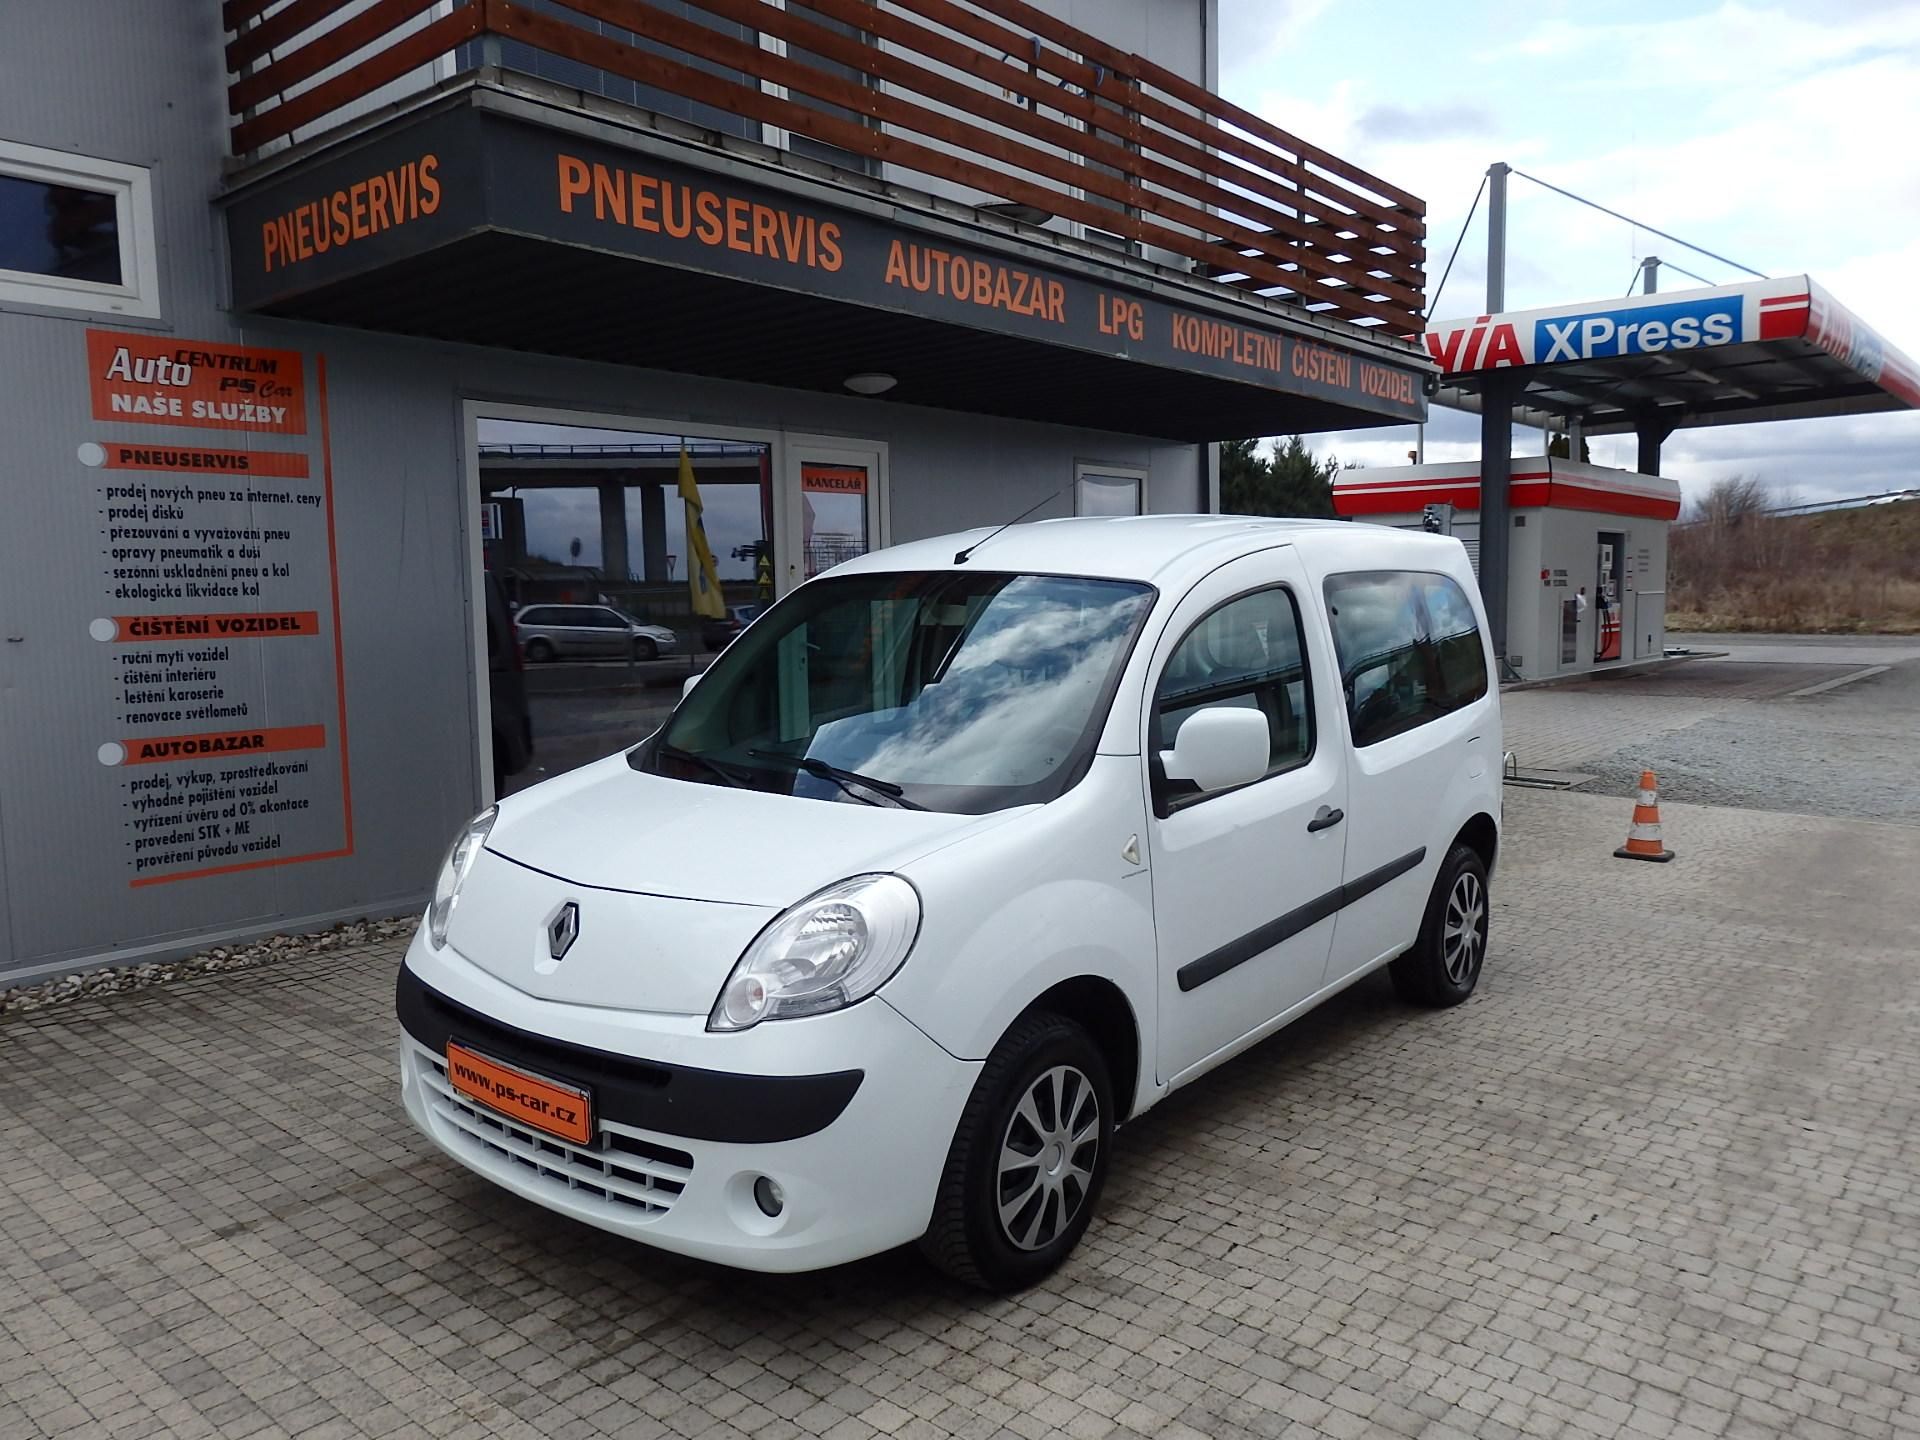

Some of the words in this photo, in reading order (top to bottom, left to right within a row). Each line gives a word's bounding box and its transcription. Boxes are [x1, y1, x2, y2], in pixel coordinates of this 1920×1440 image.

[262, 154, 440, 272] PNEUSERVIS
[556, 153, 843, 272] PNEUSERVIS
[884, 239, 1065, 323] AUTOBAZAR
[1099, 293, 1143, 341] LPG
[1171, 313, 1282, 372] KOMPLETNÍ
[1292, 335, 1351, 388] ČIŠTĚNÍ
[1360, 363, 1415, 405] VOZIDEL
[1400, 316, 1525, 374] VIA
[1544, 312, 1733, 363] XPress
[105, 347, 192, 387] Auto
[175, 350, 277, 374] CENTRUM
[219, 377, 256, 393] PS
[259, 380, 293, 399] Car
[111, 392, 183, 417] NAŠE
[192, 399, 286, 424] SLUŽBY
[120, 449, 248, 470] PNEUSERVIS
[107, 483, 146, 502] prodej
[151, 485, 193, 503] nových
[198, 490, 226, 503] pneu
[229, 491, 243, 501] za
[247, 488, 294, 503] internet.
[296, 494, 321, 508] ceny
[108, 504, 148, 522] prodej
[110, 525, 179, 542] přezouvání
[182, 529, 190, 539] a
[264, 530, 290, 543] pneu
[112, 549, 155, 562] opravy
[161, 544, 223, 562] pneumatik
[227, 549, 235, 558] a
[164, 563, 228, 578] uskladnění
[231, 567, 258, 580] pneu
[262, 567, 269, 577] a
[272, 562, 290, 576] kol
[115, 583, 181, 601] ekologická
[186, 582, 238, 597] likvidace
[242, 581, 260, 596] kol
[129, 616, 209, 635] ČIŠTĚNÍ
[215, 616, 300, 633] VOZIDEL
[122, 651, 152, 664] ruční
[187, 646, 229, 661] vozidel
[169, 685, 224, 702] karoserie
[126, 710, 181, 723] renovace
[140, 734, 264, 758] AUTOBAZAR
[131, 772, 172, 794] prodej,
[239, 780, 278, 797] vozidel
[222, 803, 236, 818] od
[239, 801, 256, 816] 0%
[259, 798, 309, 814] akontace
[135, 828, 195, 852] provedení
[198, 823, 220, 840] STK
[234, 820, 250, 835] ME
[242, 834, 281, 852] vozidel
[454, 1062, 577, 1125] www.ps-car.cz
